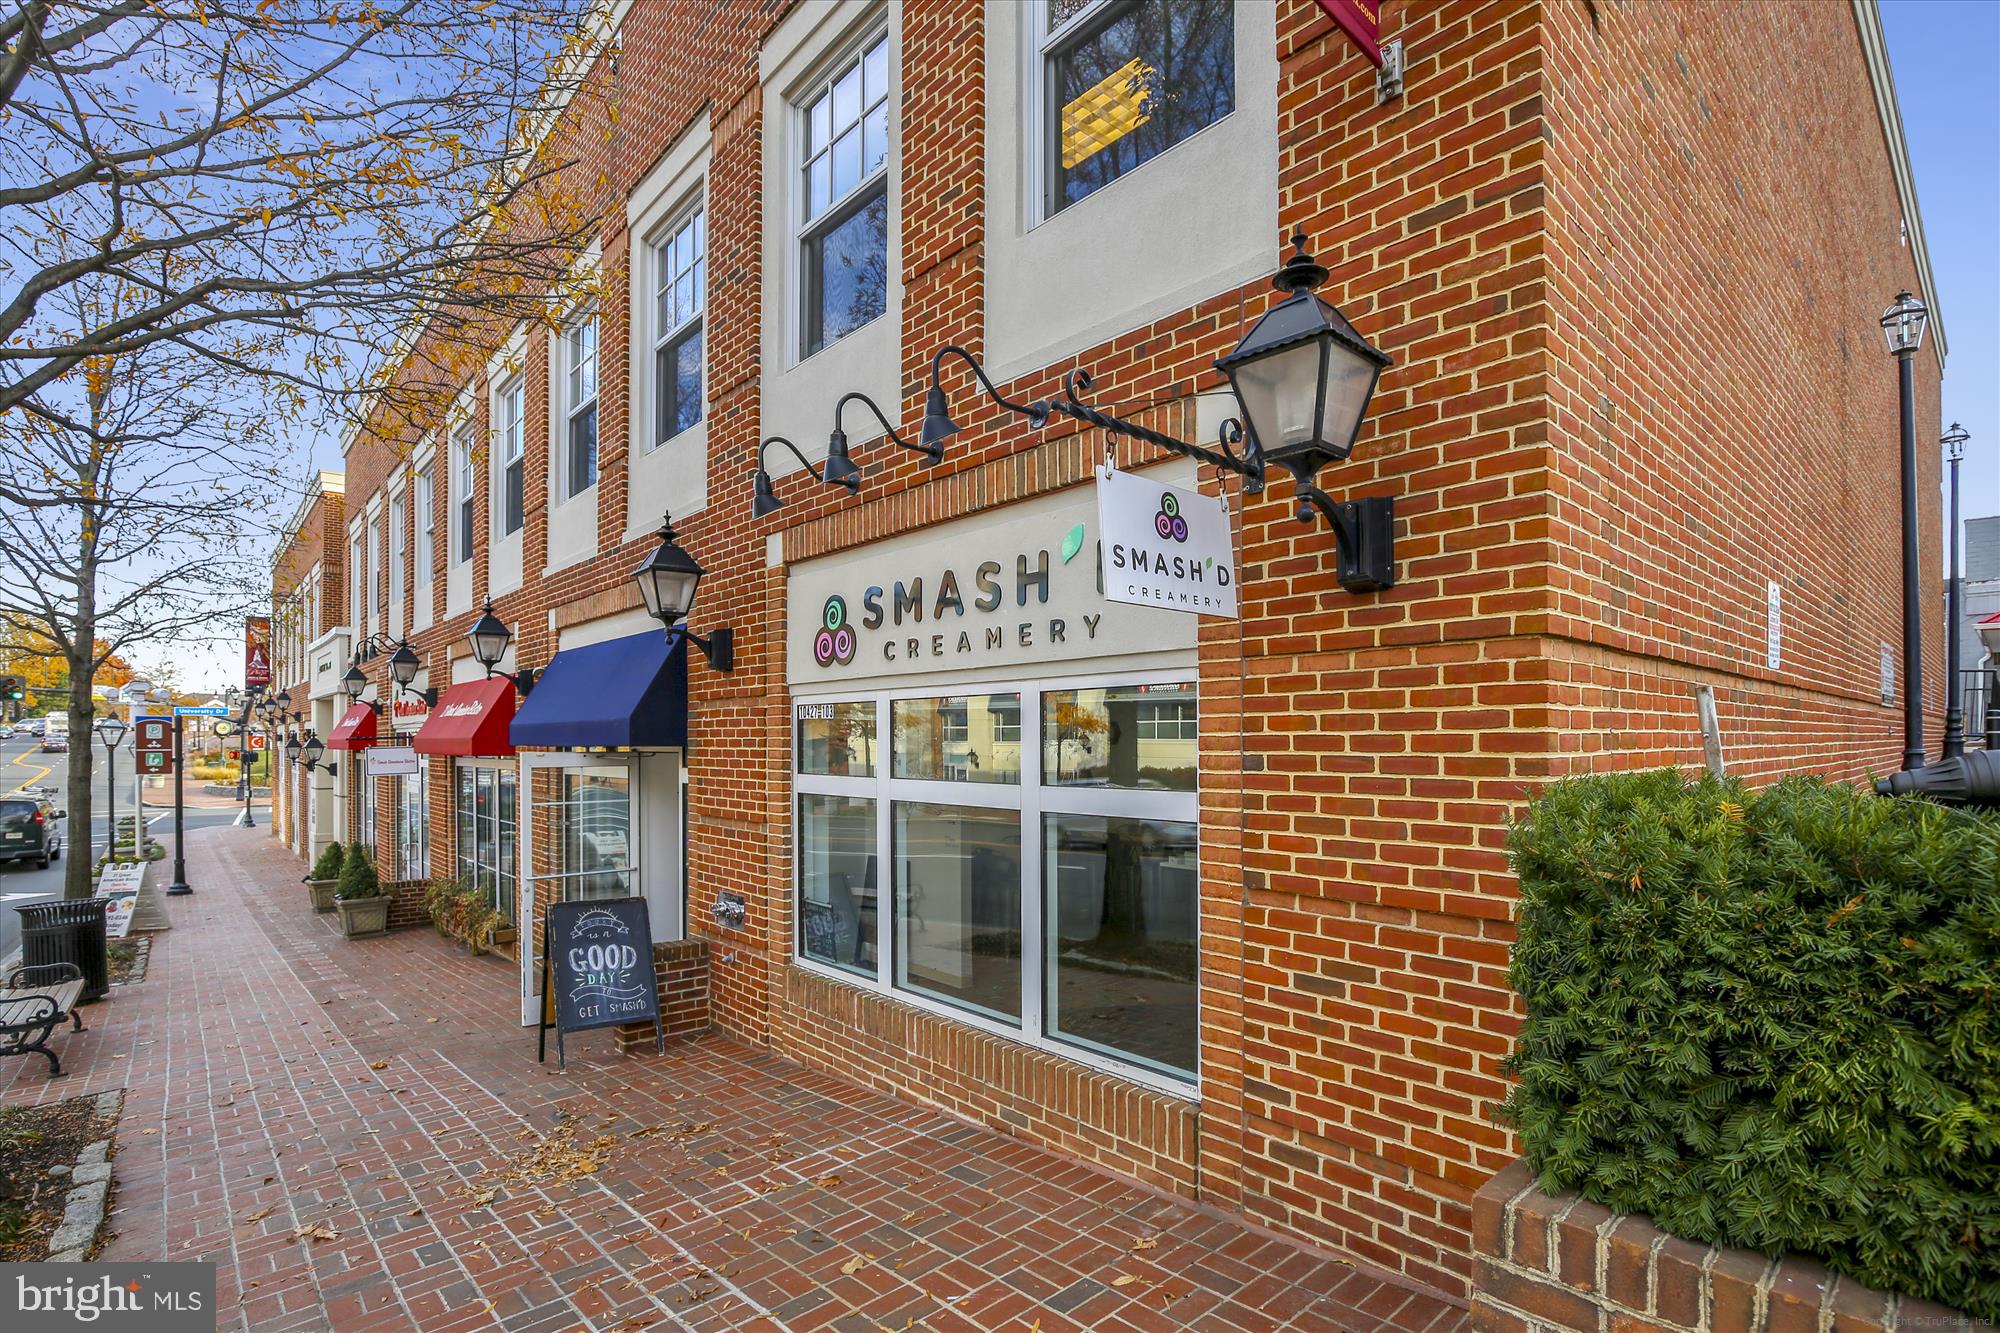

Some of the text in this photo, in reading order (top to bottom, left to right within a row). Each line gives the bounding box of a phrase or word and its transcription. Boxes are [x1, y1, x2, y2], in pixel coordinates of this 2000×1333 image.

[1113, 544, 1230, 586] SMASH'D
[1128, 585, 1221, 608] CREAMERY
[884, 613, 1100, 661] CREAMERY
[568, 944, 637, 972] GOOD
[588, 972, 615, 984] DAY
[580, 999, 646, 1018] GET SMASH'D
